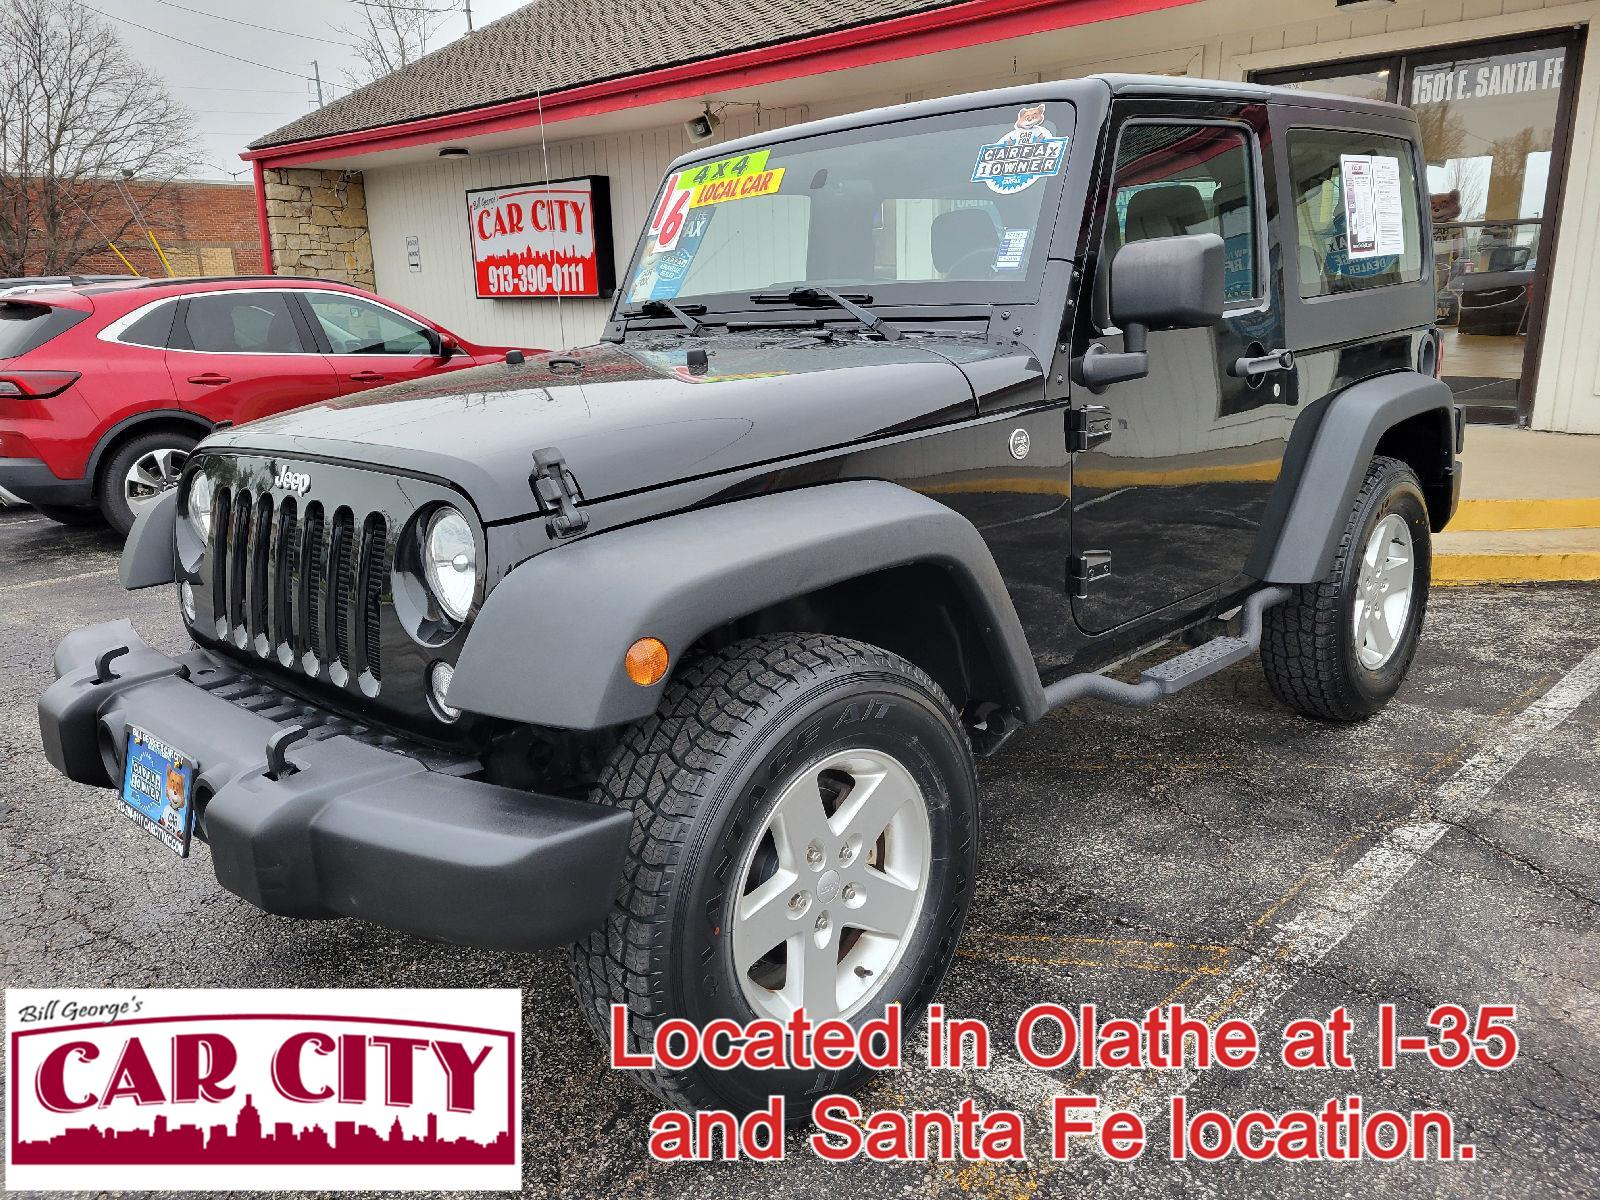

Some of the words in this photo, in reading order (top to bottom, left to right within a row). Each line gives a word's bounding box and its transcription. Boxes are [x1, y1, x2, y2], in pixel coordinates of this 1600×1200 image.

[1412, 71, 1454, 105] 1501
[1456, 69, 1472, 100] E.
[1476, 60, 1537, 98] SANTA
[1542, 56, 1565, 90] FE
[984, 144, 1061, 161] CARFAX
[696, 179, 740, 204] LOCAL
[741, 172, 774, 195] CAR
[477, 202, 524, 242] CAR
[531, 199, 586, 235] CITY
[488, 262, 585, 293] 913-390-0111
[274, 464, 311, 498] Jeep
